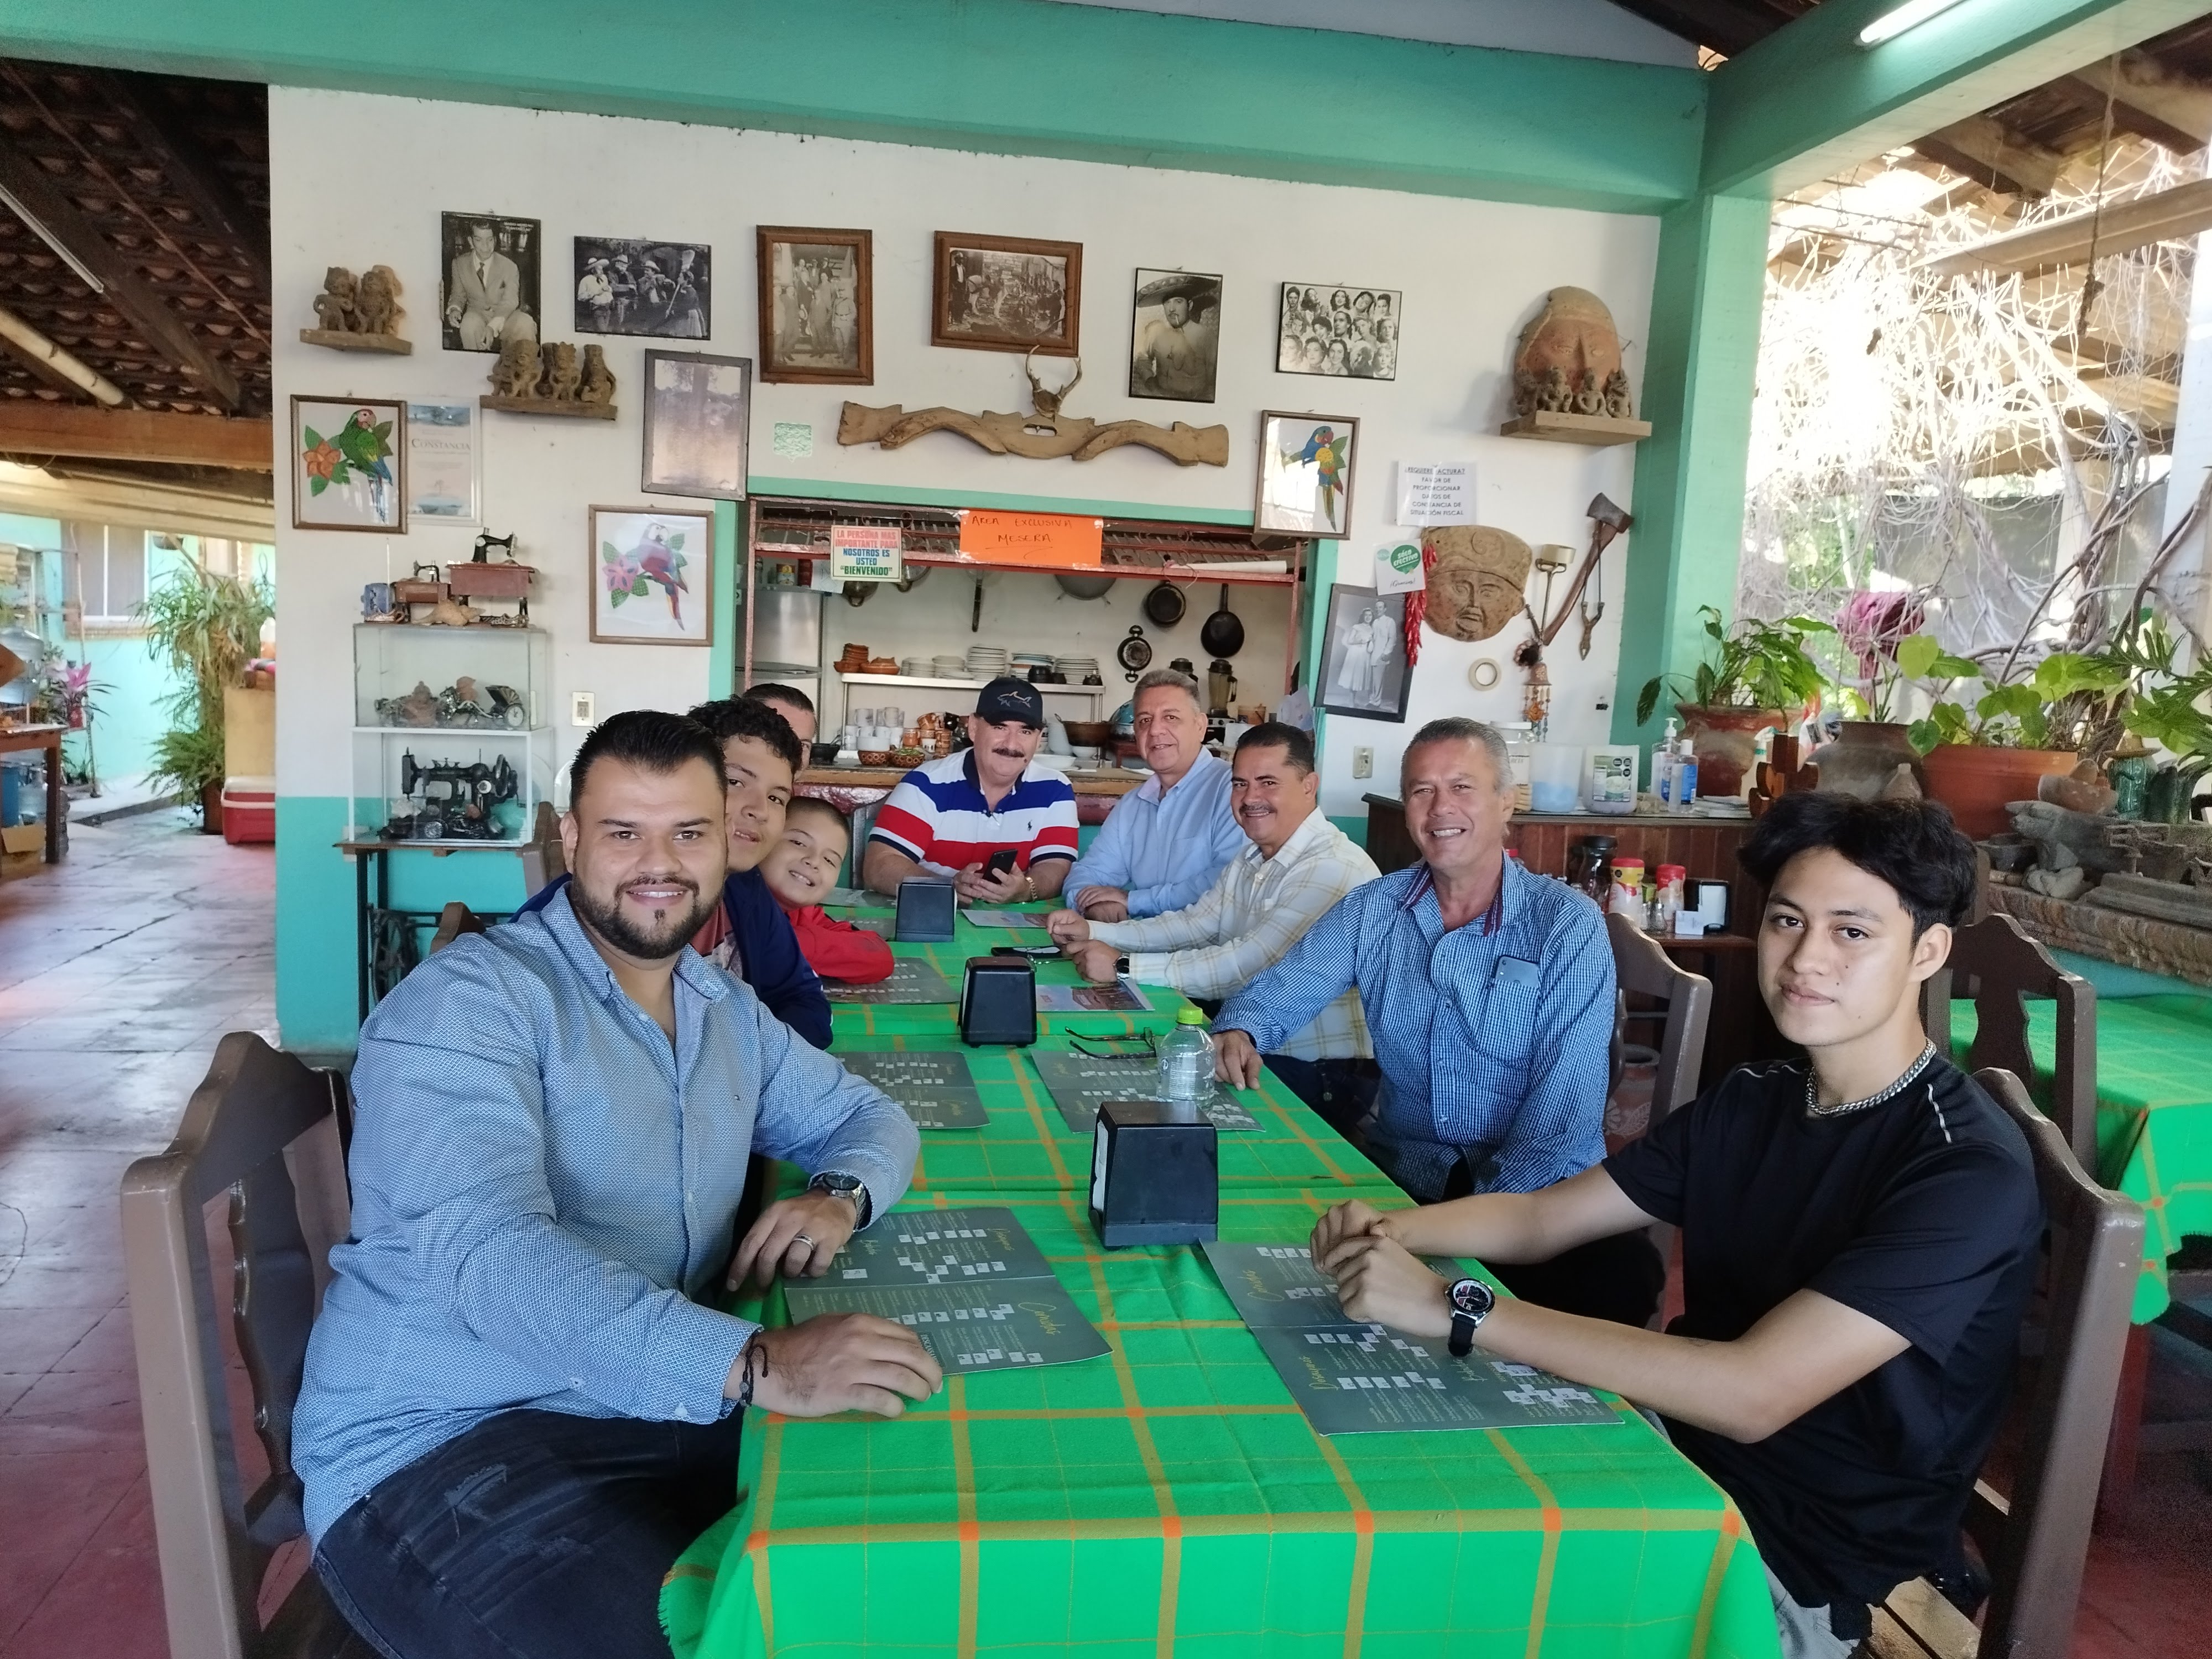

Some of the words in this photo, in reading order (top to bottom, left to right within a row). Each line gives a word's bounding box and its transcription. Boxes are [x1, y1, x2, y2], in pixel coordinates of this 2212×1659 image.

[972, 515, 999, 525] AREA
[1015, 518, 1072, 528] EXCLUSIVA
[847, 530, 878, 539] PERSONA
[836, 539, 877, 547] IMPORTANTE
[880, 540, 898, 549] PARA
[843, 548, 879, 556] NOSOTROS
[1018, 1302, 1066, 1335] Comidas
